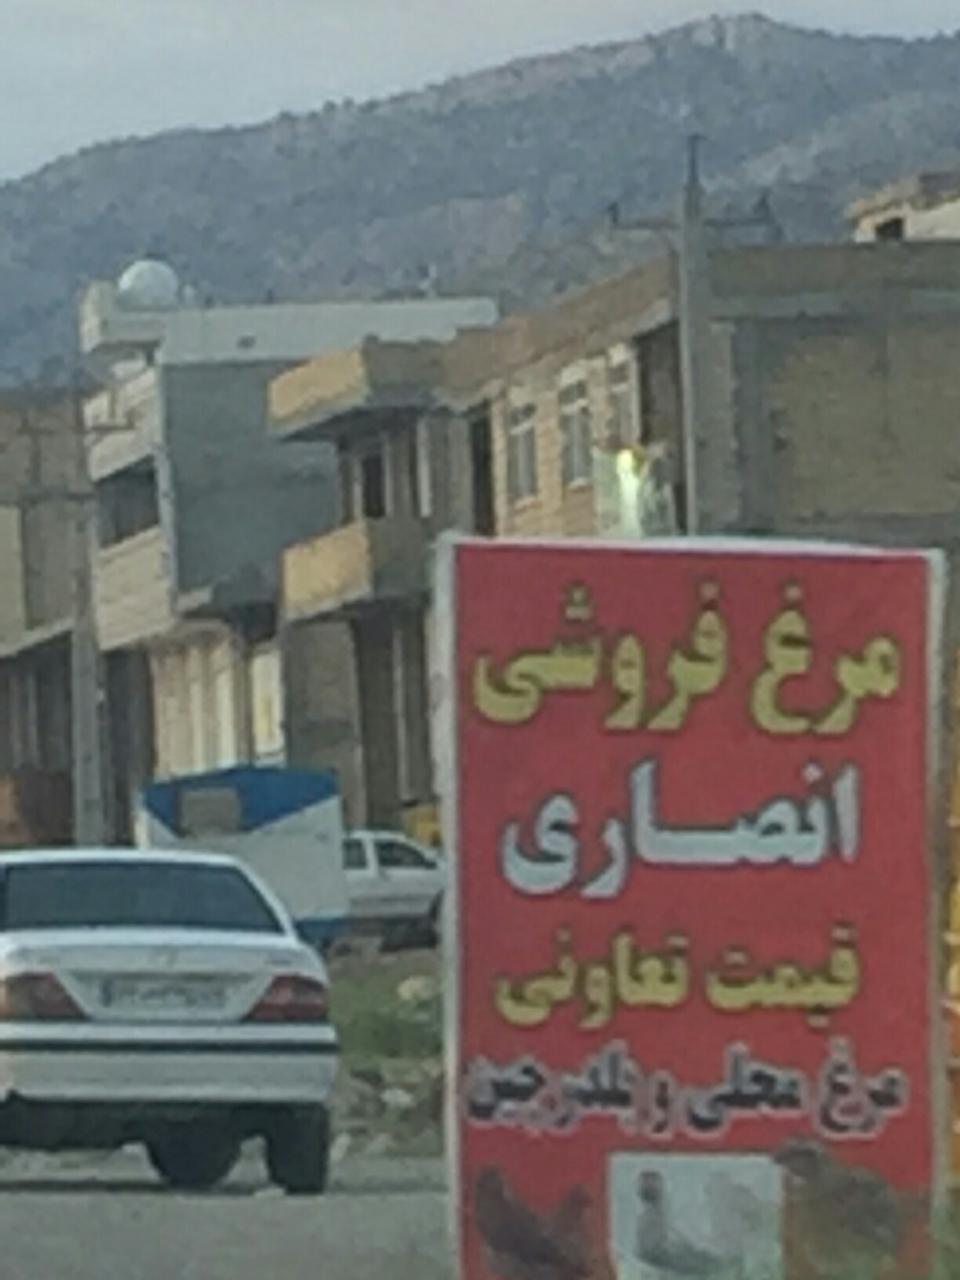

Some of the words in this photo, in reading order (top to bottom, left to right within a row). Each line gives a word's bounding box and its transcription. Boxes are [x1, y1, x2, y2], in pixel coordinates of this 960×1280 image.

[473, 581, 729, 732] فروشی
[751, 581, 899, 734] مرغ
[502, 754, 860, 898] انصاری
[496, 926, 689, 1029] تعاونی
[706, 926, 859, 1029] قیمت
[685, 1041, 804, 1136] محلی
[816, 1037, 908, 1136] مرغ
